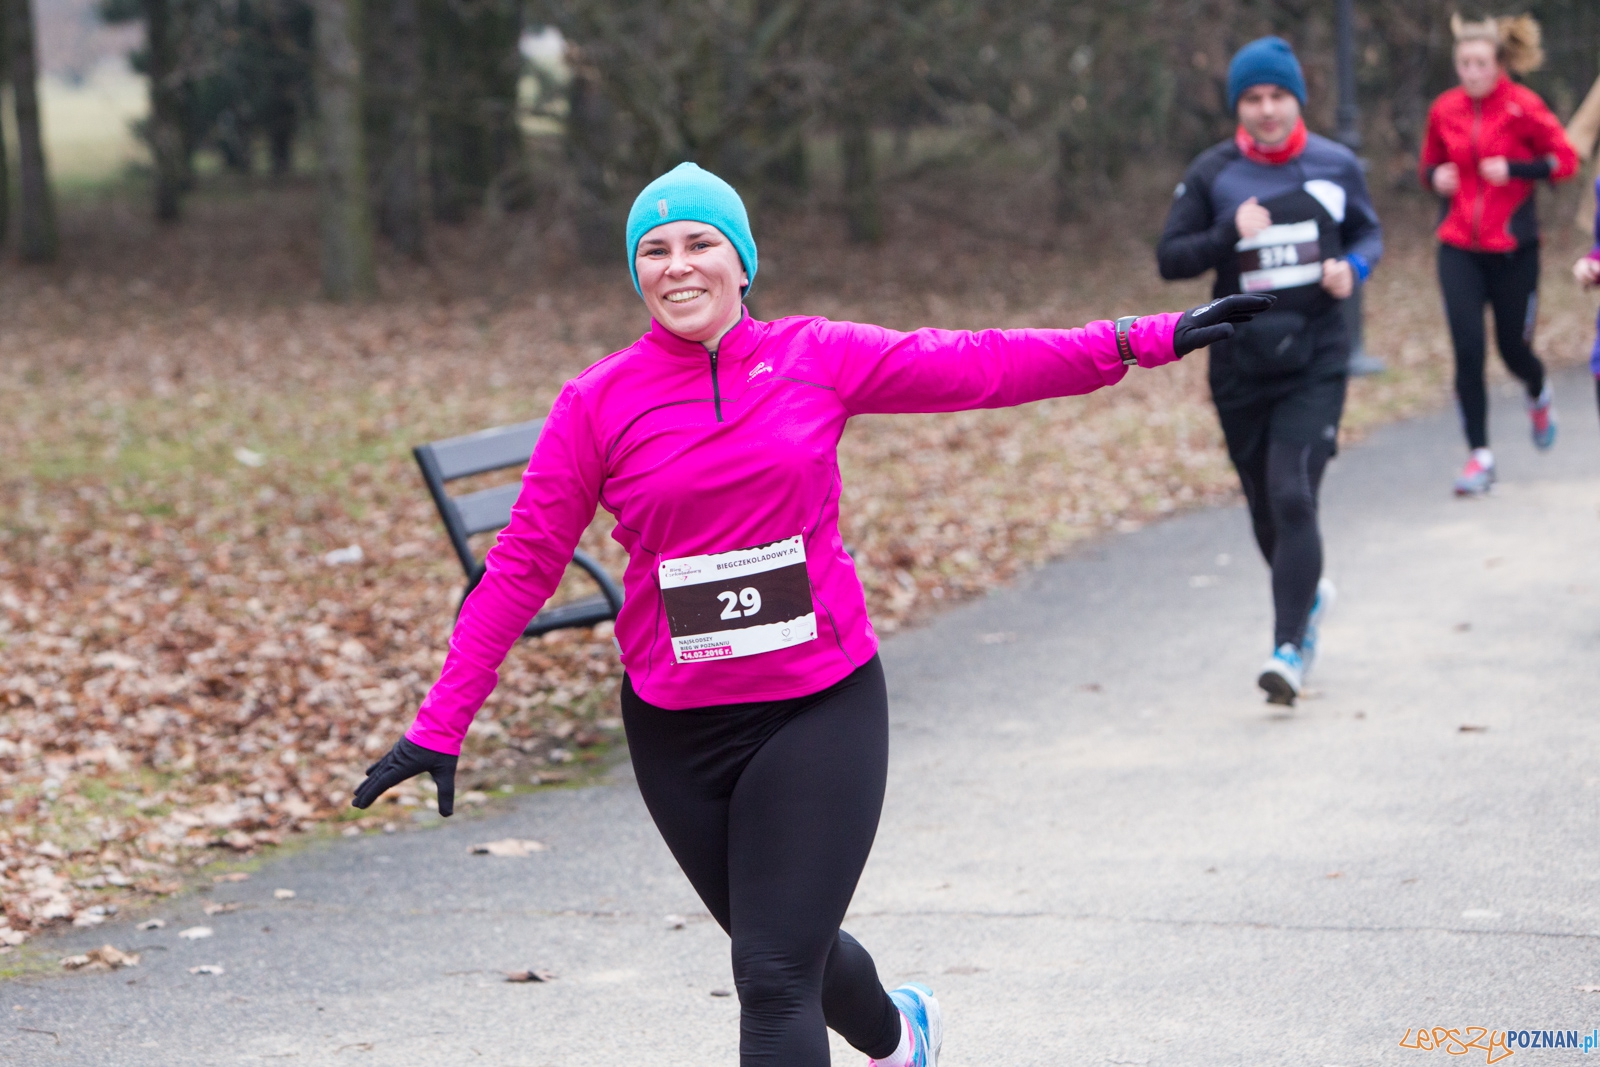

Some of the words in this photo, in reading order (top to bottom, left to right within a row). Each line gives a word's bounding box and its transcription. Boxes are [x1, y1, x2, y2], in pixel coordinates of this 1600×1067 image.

[716, 548, 798, 570] BIEGCZEKOLADOWY.PL
[716, 587, 762, 620] 29
[700, 641, 730, 649] POZNANIU
[682, 648, 724, 660] 14.02.2016
